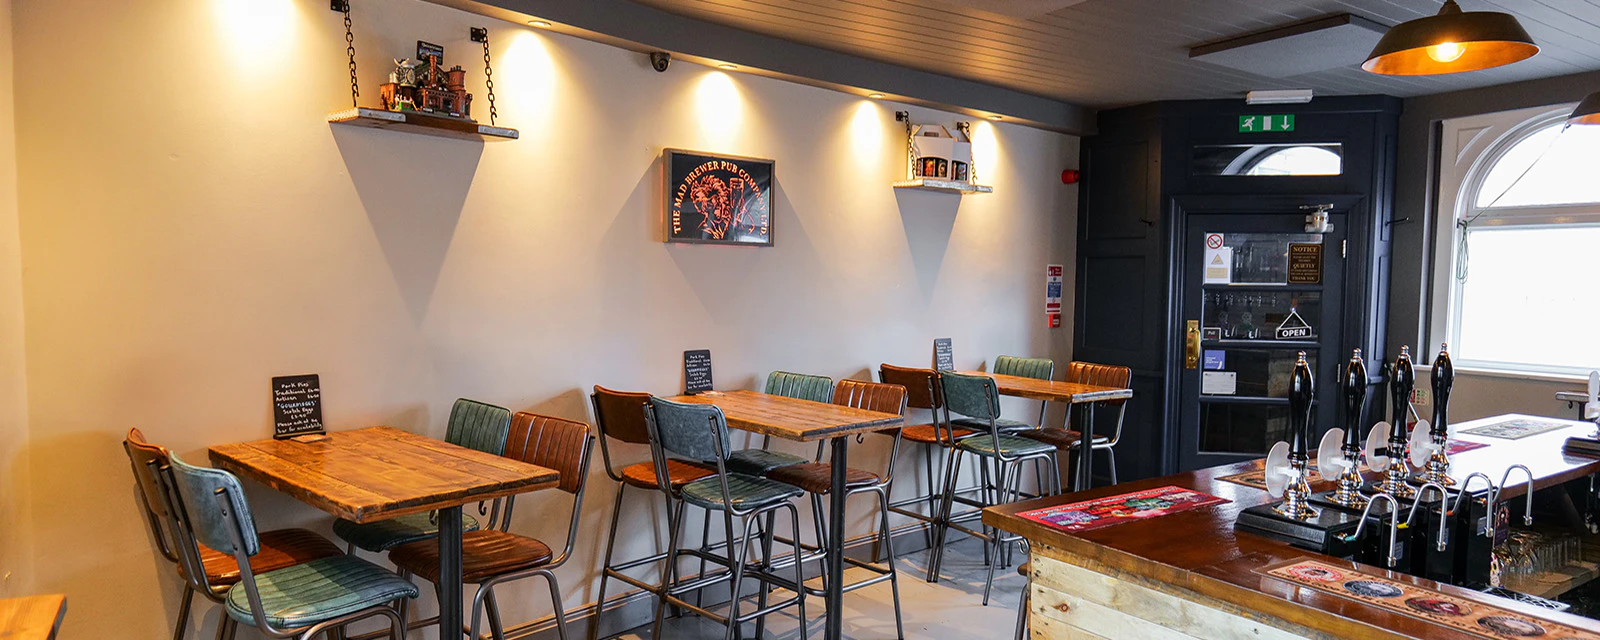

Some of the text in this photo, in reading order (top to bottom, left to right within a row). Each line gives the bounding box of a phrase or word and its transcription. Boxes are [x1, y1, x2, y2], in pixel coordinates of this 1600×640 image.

[685, 160, 719, 185] BREWER
[721, 160, 738, 174] PUB
[674, 183, 688, 208] MAD
[738, 168, 766, 211] COMPANY
[673, 210, 682, 234] THE
[1282, 329, 1306, 337] OPEN
